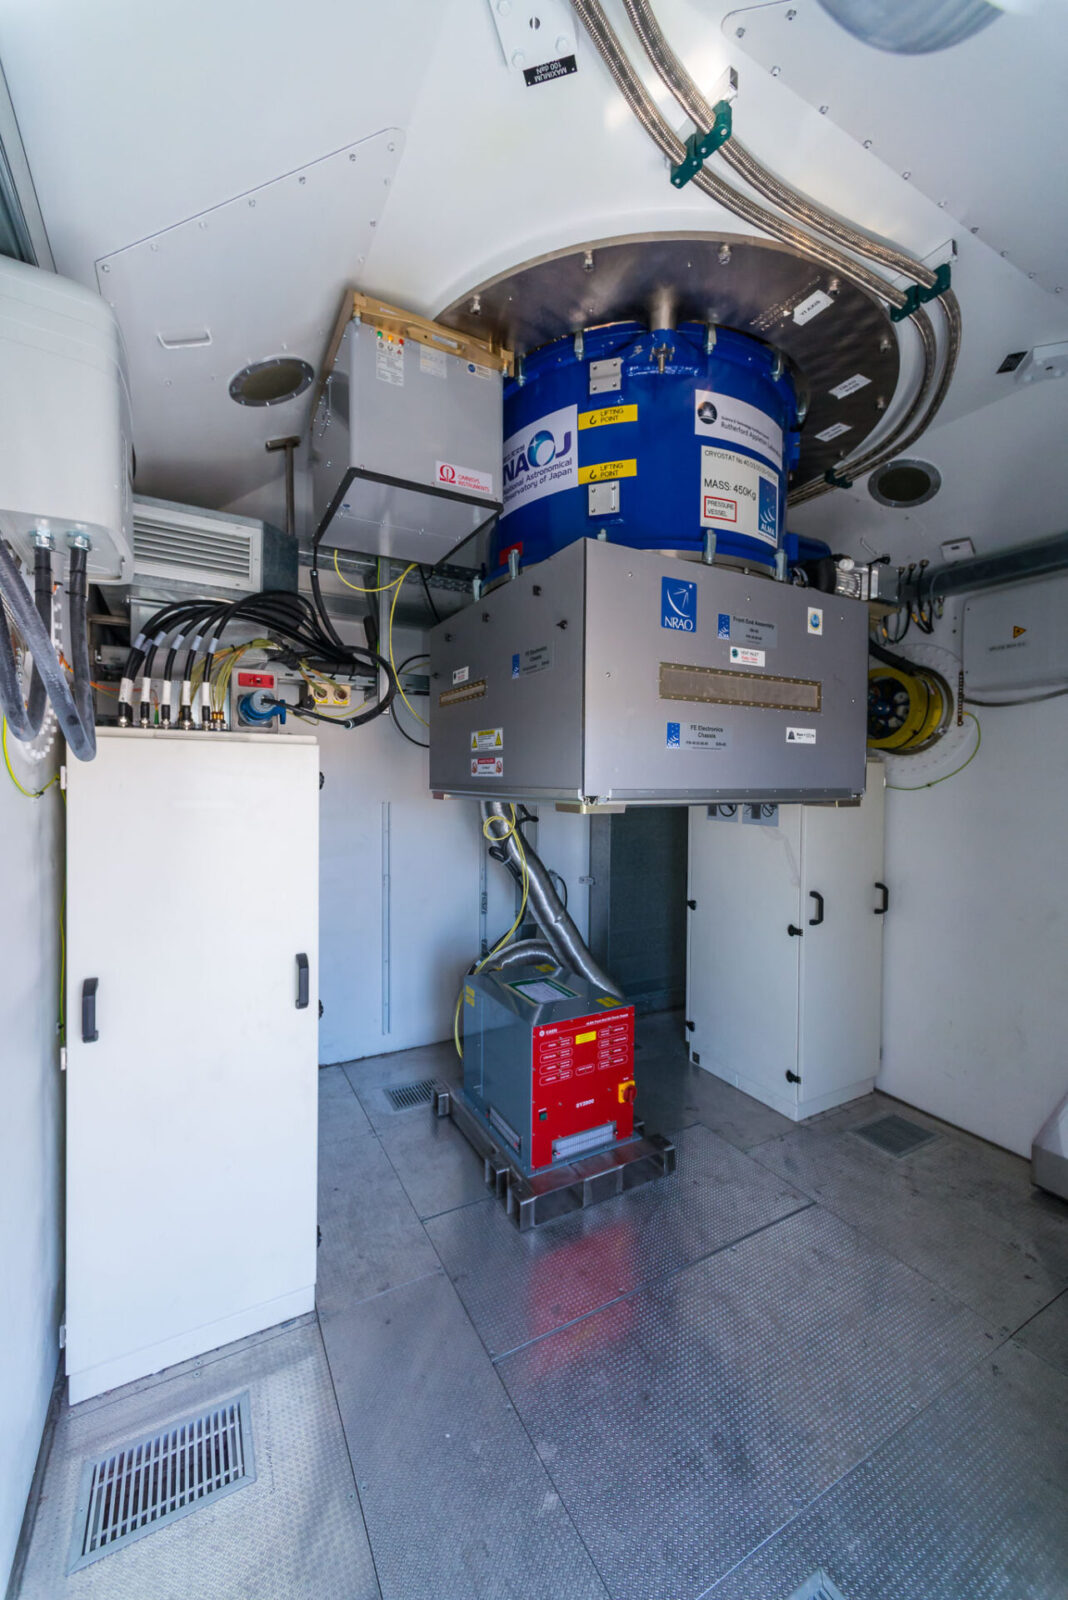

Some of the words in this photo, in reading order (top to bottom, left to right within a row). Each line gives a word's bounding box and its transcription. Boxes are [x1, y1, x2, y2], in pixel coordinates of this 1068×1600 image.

[550, 61, 562, 71] 100
[534, 67, 568, 82] MAXIMUM
[600, 407, 624, 417] LIFTING
[600, 415, 619, 423] POINT
[704, 450, 735, 462] CRYOSTAT
[526, 457, 572, 482] Astronomical
[600, 462, 624, 471] LIFTING
[539, 475, 548, 485] of
[548, 468, 572, 481] Japan
[600, 470, 619, 478] POINT
[704, 478, 732, 491] MASS:
[733, 485, 757, 501] 450Kg
[707, 500, 734, 510] PRESSURE
[707, 508, 728, 517] VESSEL
[664, 616, 693, 631] NRAO
